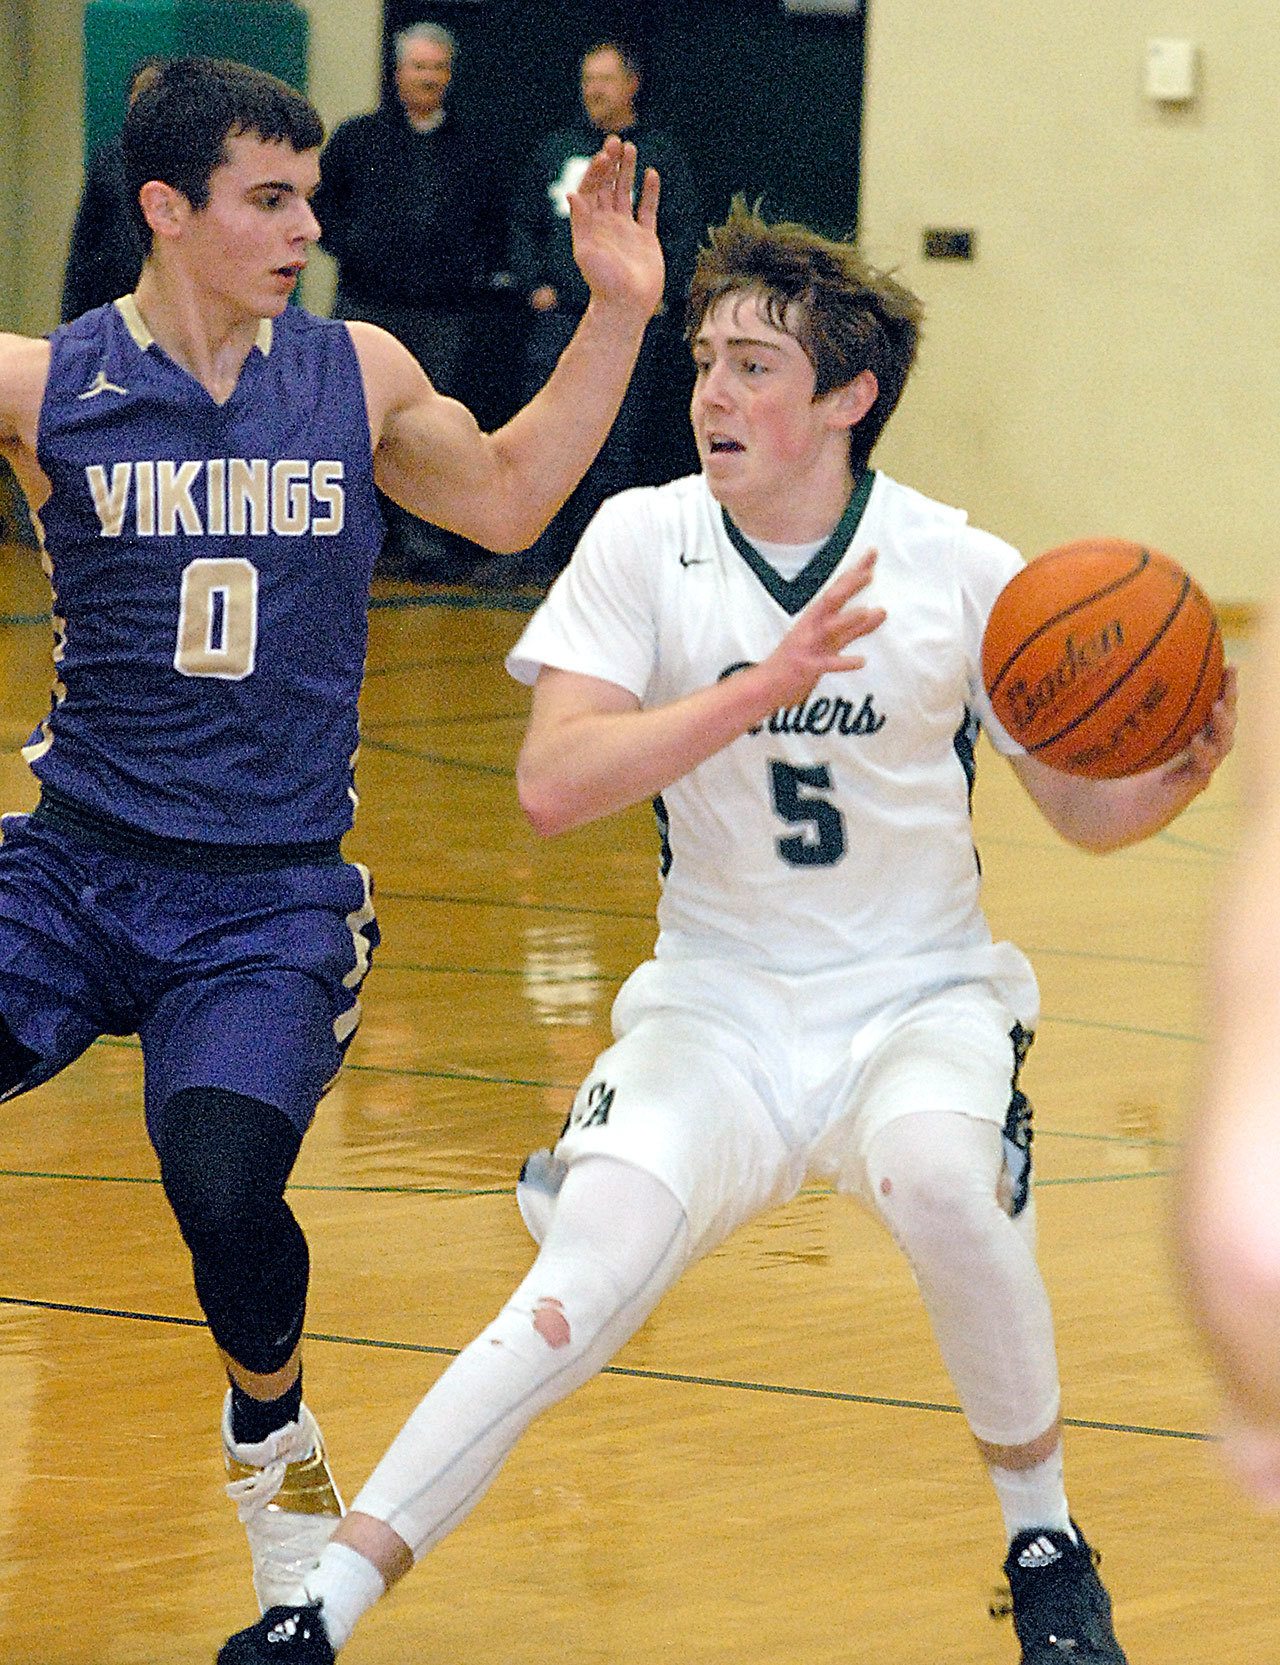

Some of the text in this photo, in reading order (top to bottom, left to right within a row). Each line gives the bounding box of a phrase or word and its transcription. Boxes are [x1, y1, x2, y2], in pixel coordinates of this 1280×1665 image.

[86, 458, 345, 536] VIKINGS
[173, 557, 258, 681] 0
[769, 758, 849, 867] 5
